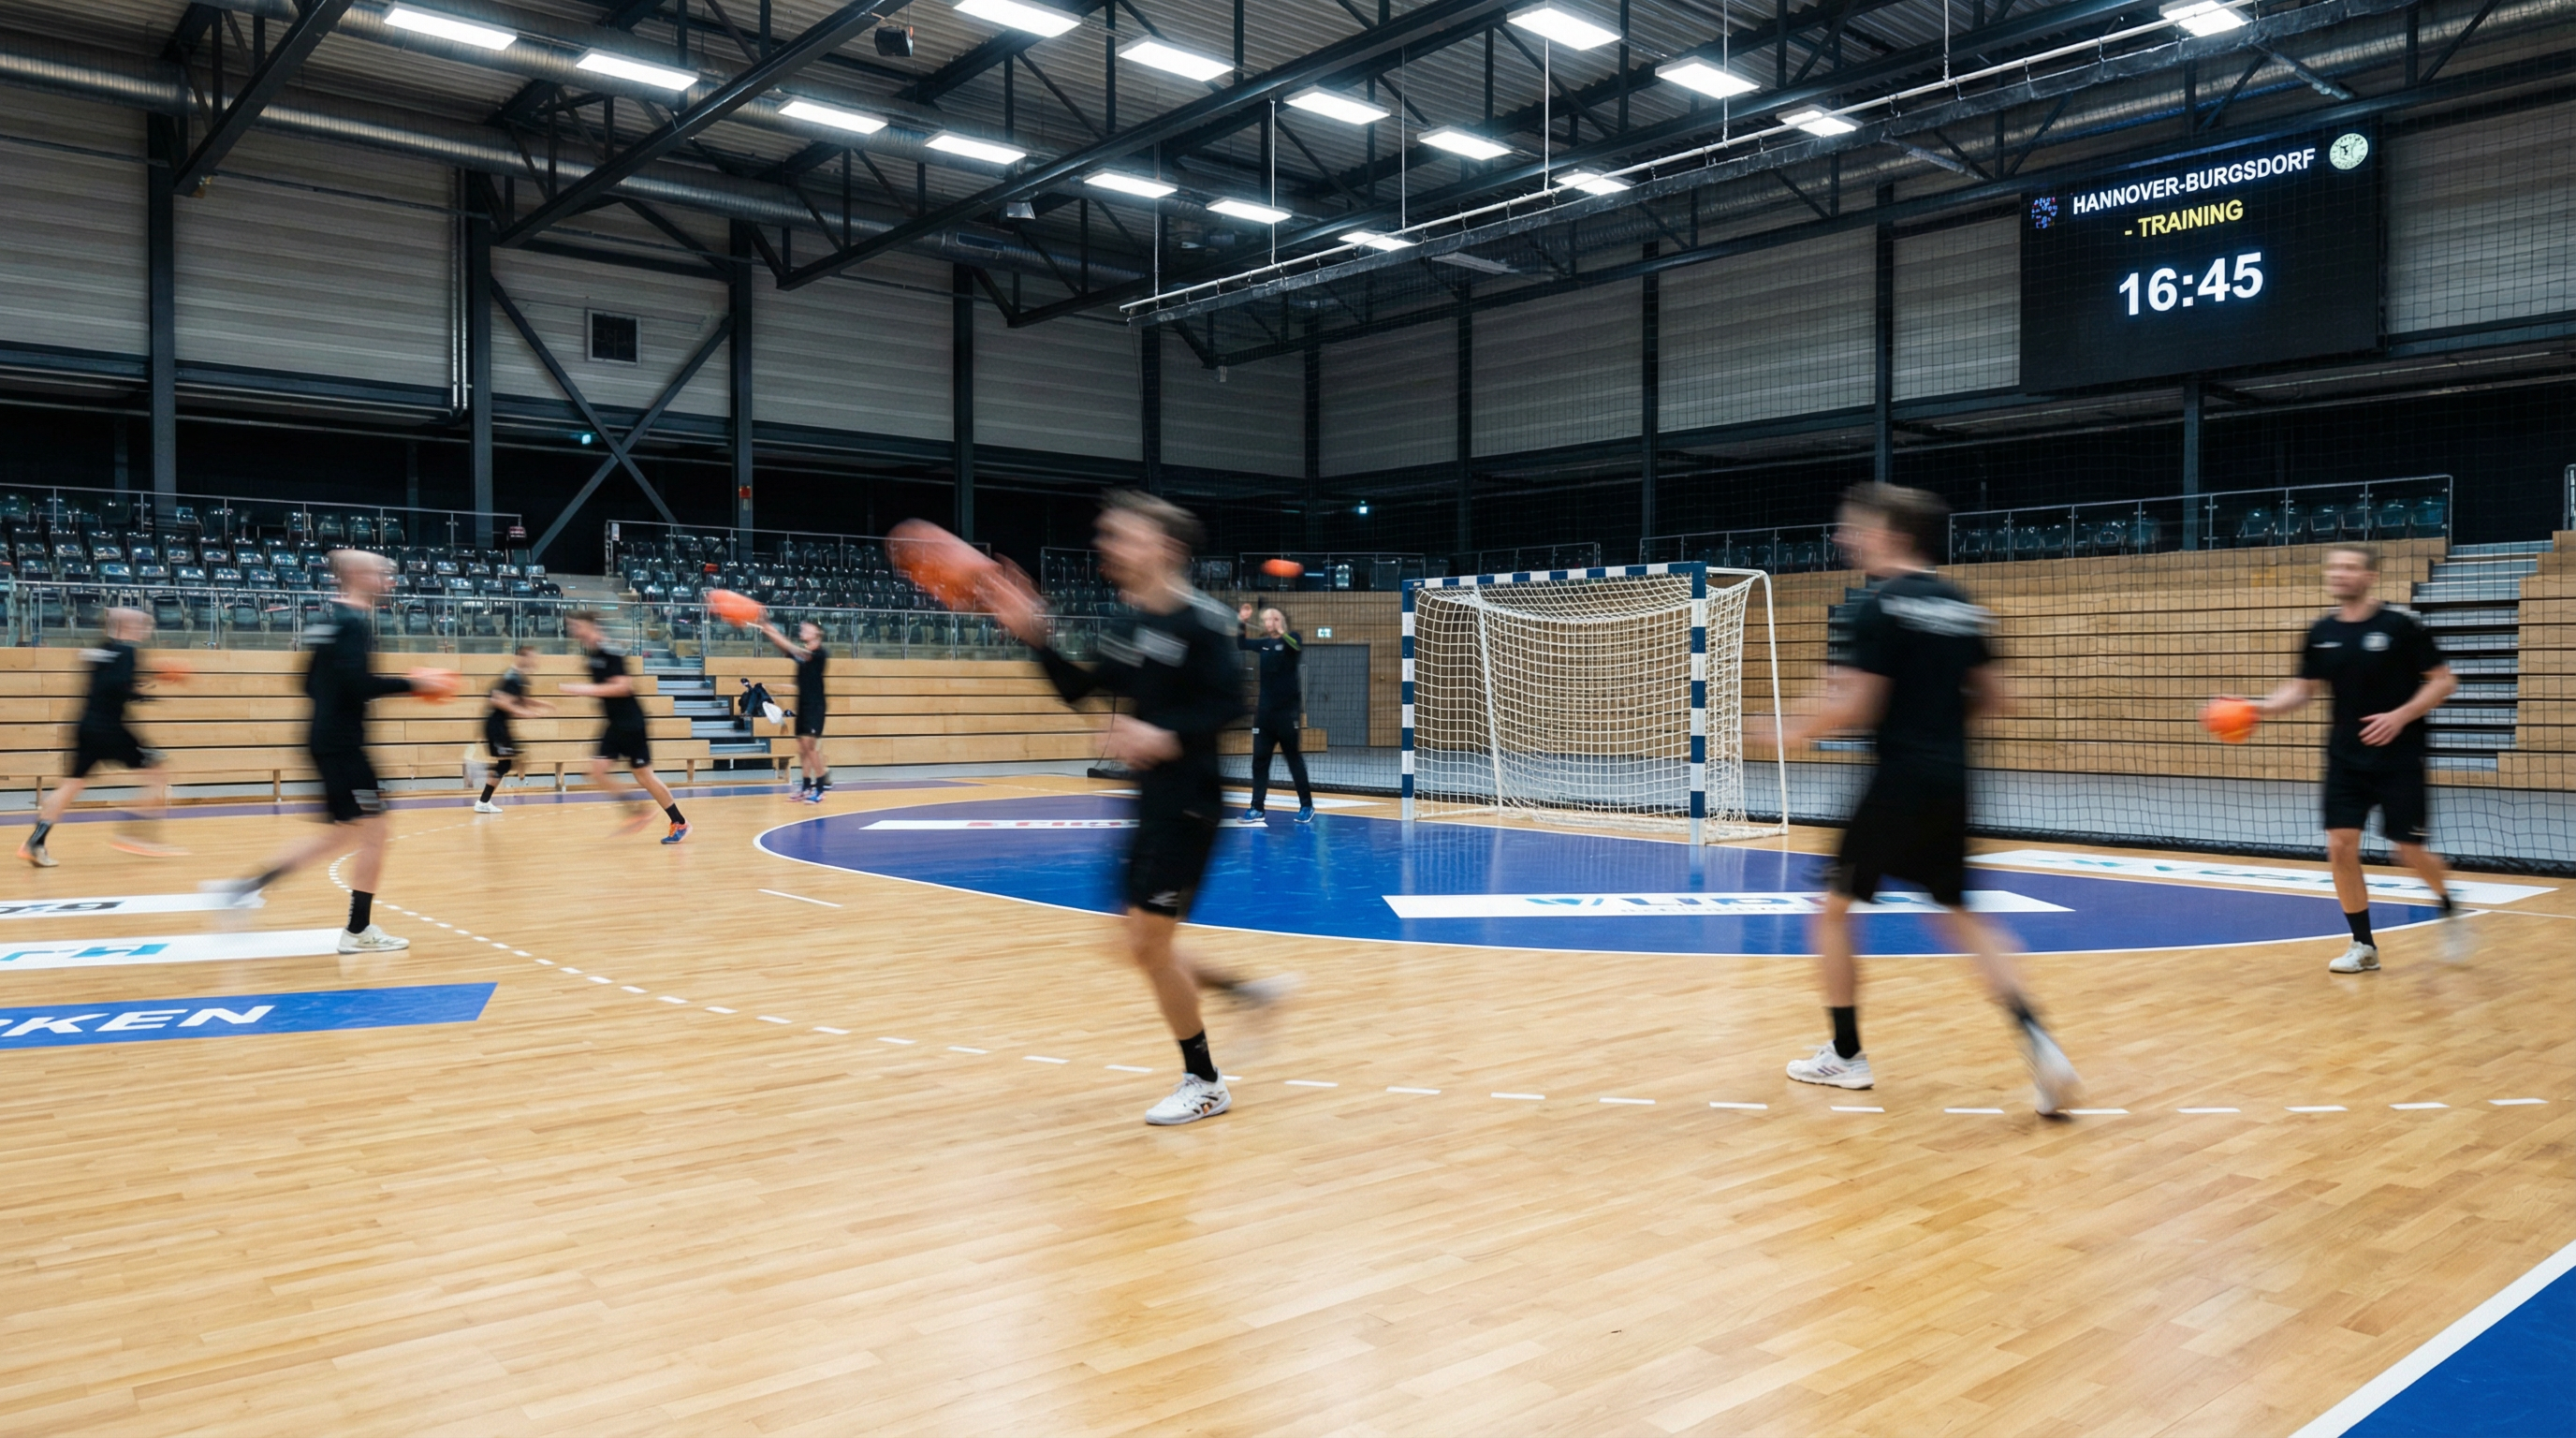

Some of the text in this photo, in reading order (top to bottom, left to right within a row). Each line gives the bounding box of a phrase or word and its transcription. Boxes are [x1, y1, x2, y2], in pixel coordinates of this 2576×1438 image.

[2072, 148, 2316, 214] HANNOVER-BURGSDORF
[2138, 199, 2244, 237] TRAINING
[2118, 252, 2264, 315] 16:45
